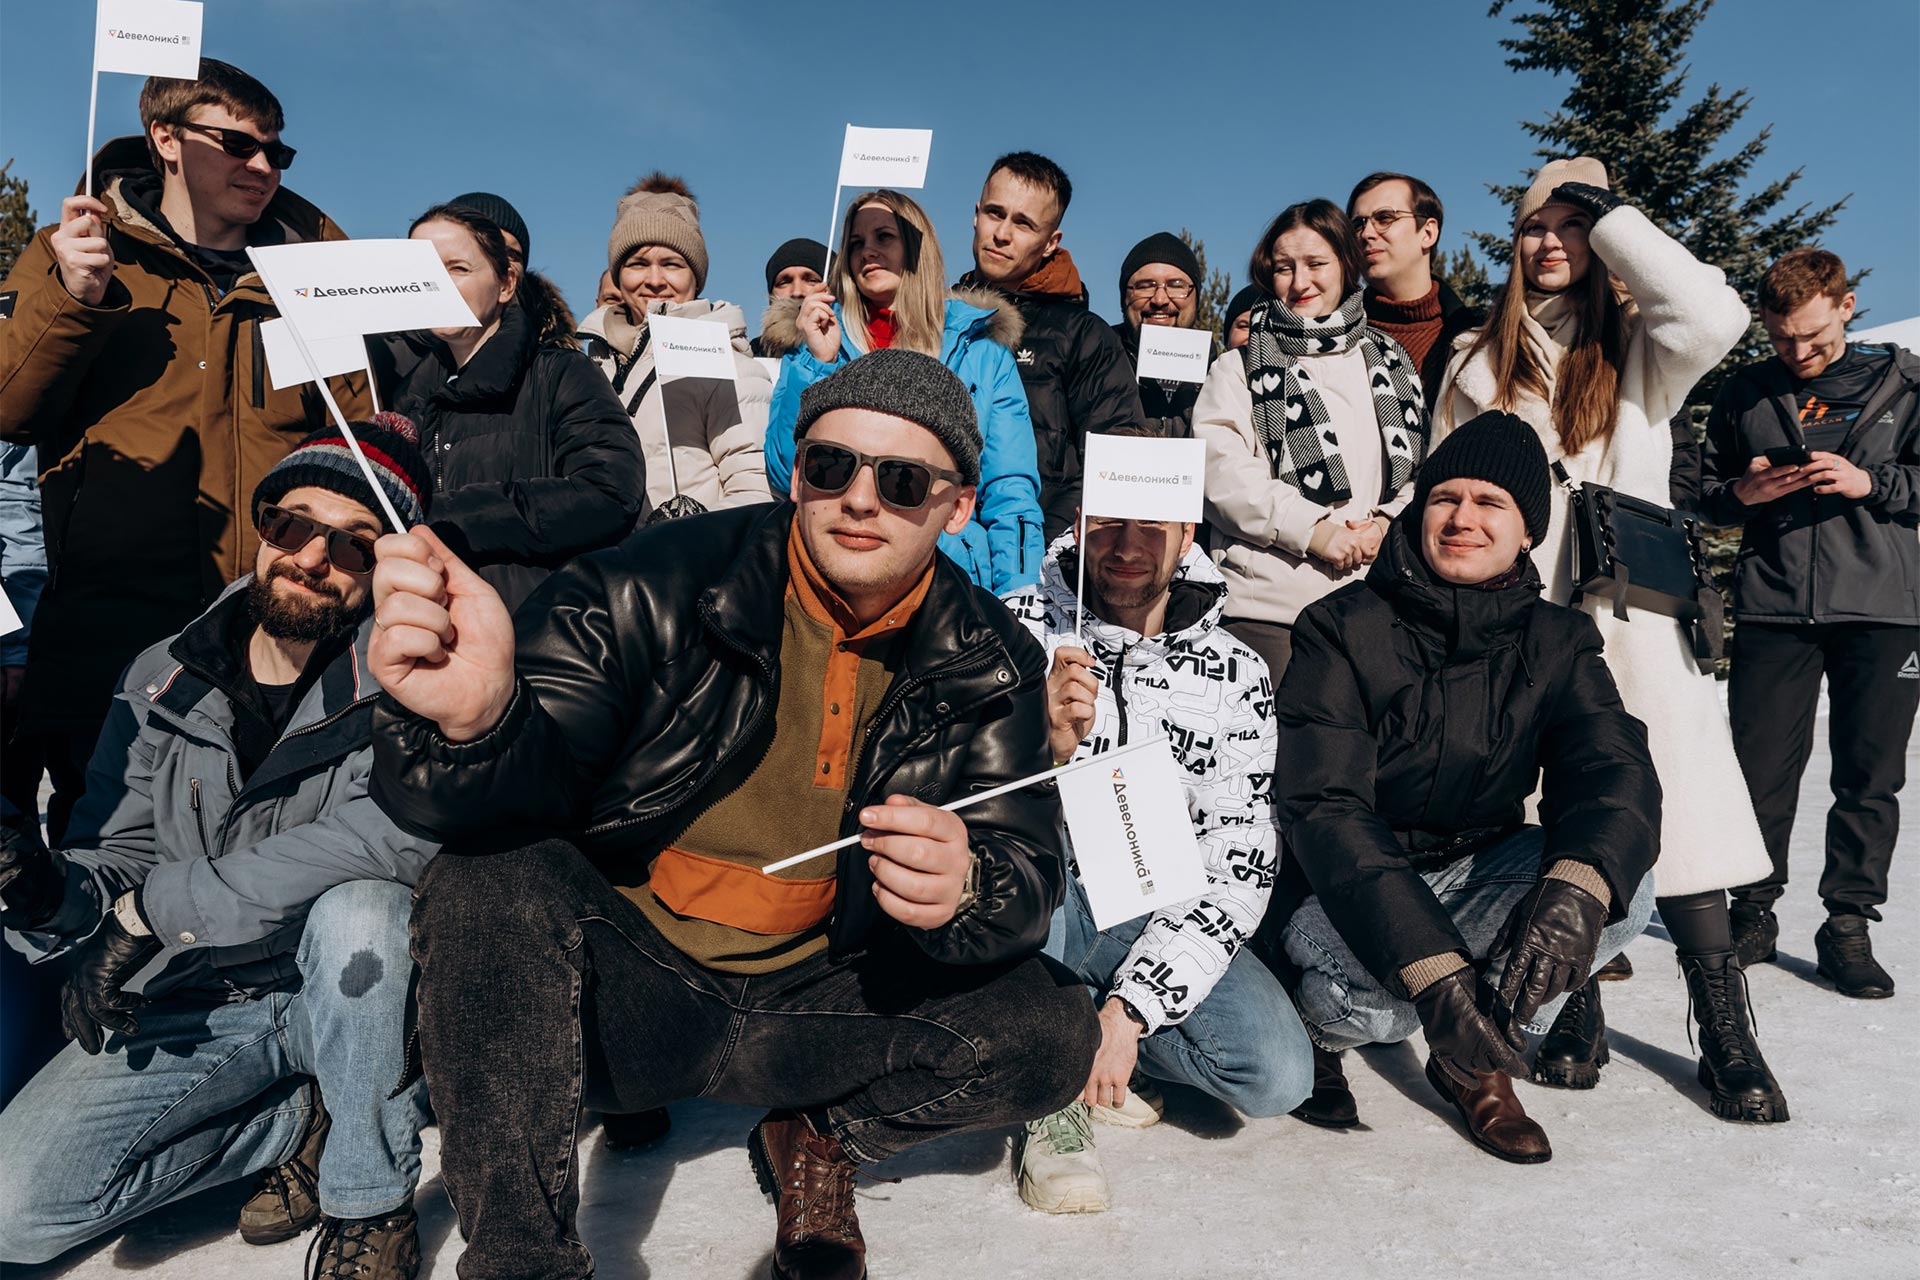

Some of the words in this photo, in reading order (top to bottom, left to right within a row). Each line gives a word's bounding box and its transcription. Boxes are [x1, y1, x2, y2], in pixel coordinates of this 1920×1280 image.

[1165, 655, 1225, 682] FILA
[1134, 676, 1170, 690] FILA
[1227, 729, 1260, 742] FILA
[1154, 917, 1184, 933] FIL
[1134, 956, 1189, 1005] FILA
